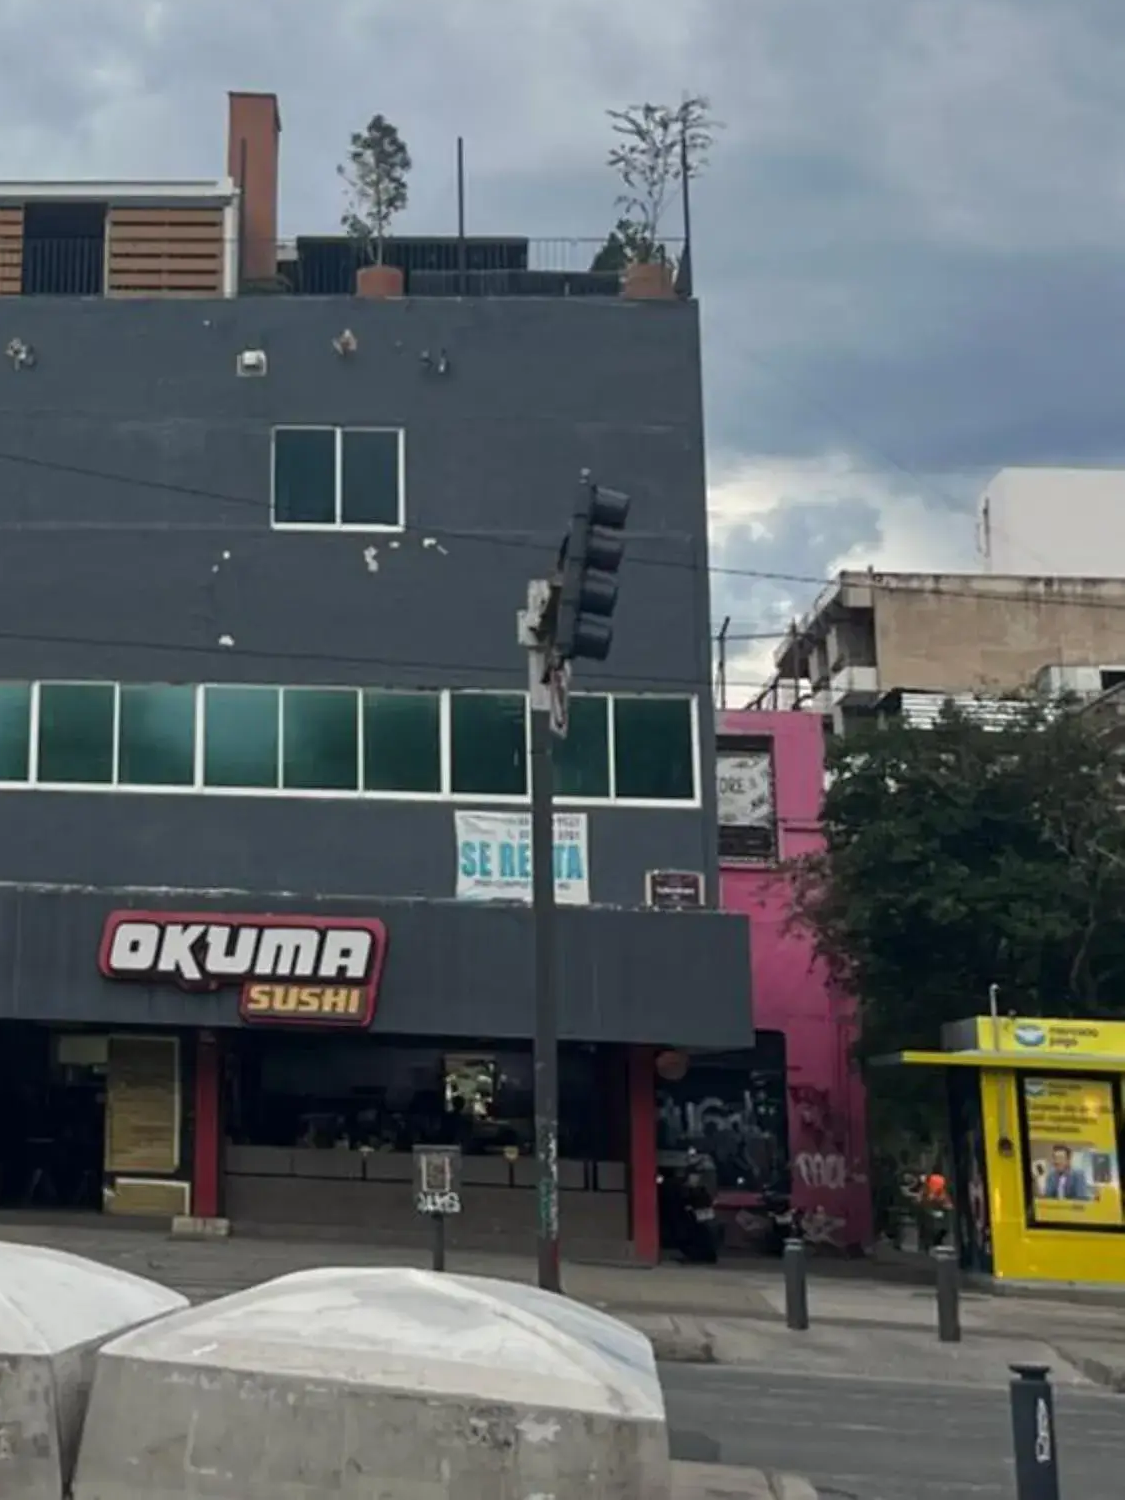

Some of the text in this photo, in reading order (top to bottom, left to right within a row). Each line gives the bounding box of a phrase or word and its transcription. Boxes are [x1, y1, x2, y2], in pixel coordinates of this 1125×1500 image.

[461, 840, 584, 879] SE RETA
[109, 923, 372, 980] OKUMA
[247, 984, 362, 1013] SUSHI
